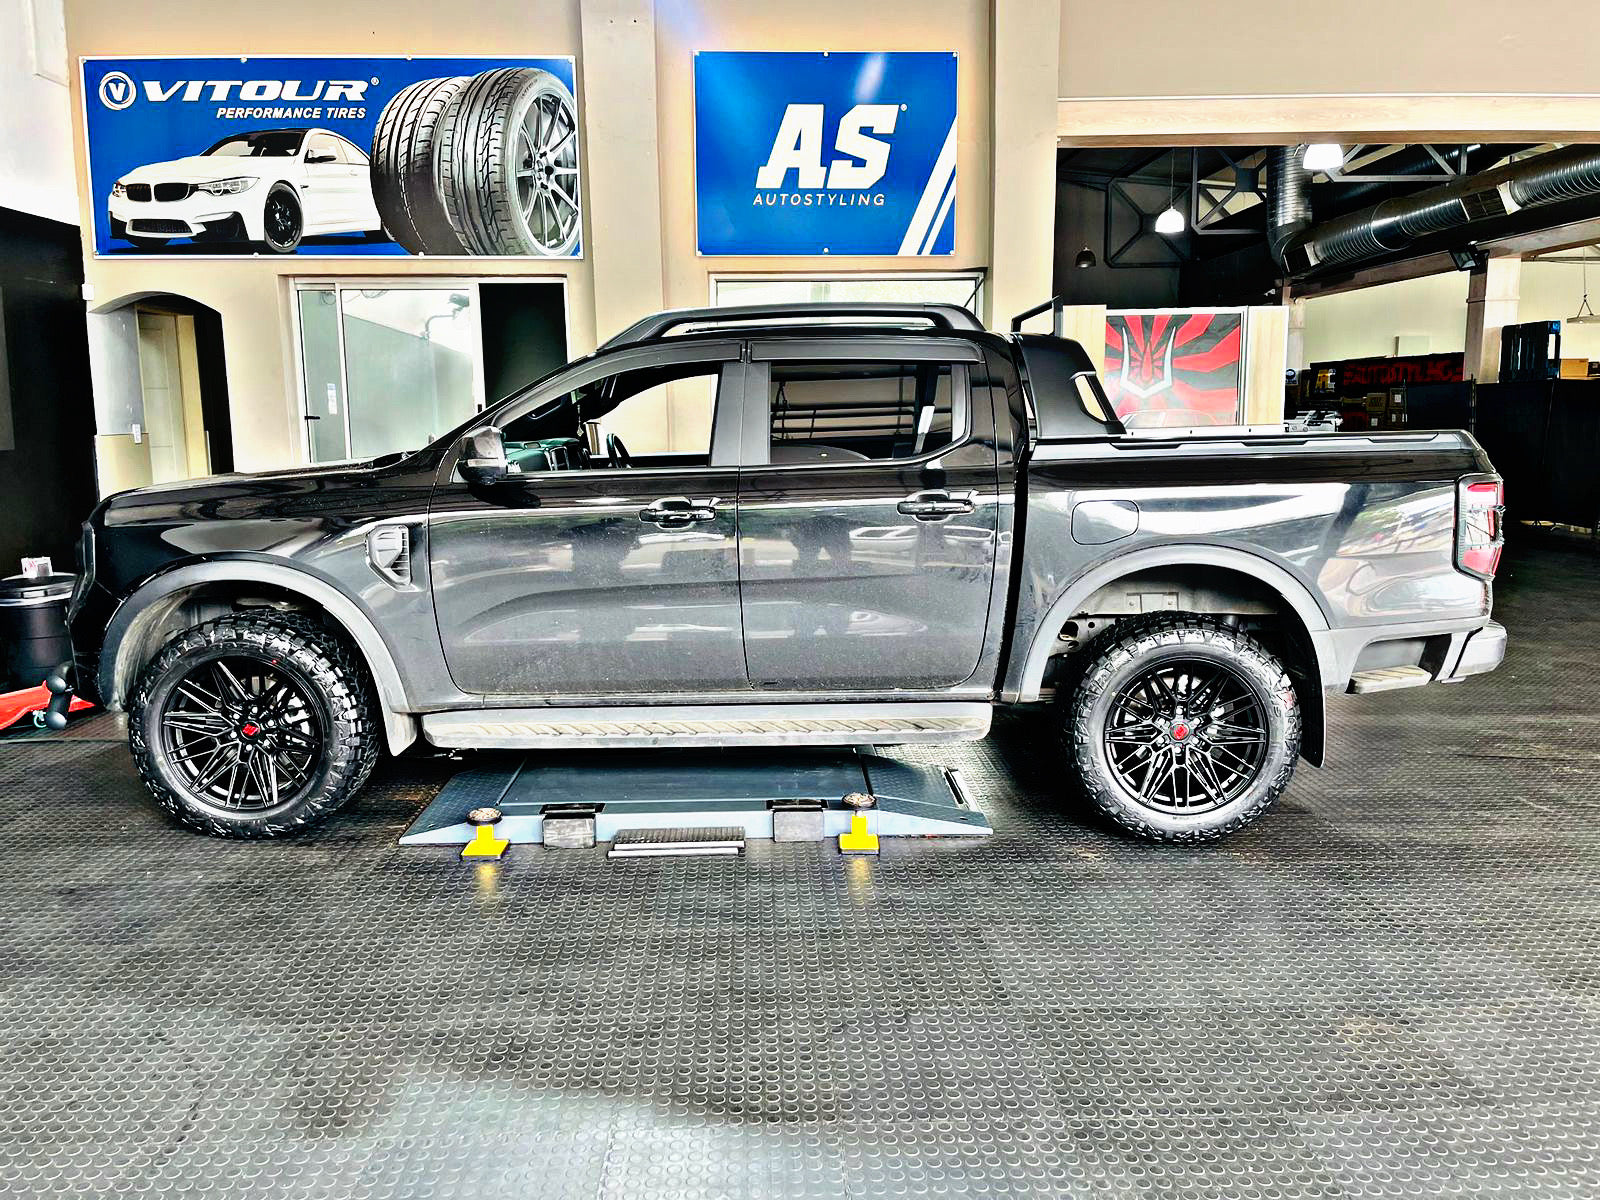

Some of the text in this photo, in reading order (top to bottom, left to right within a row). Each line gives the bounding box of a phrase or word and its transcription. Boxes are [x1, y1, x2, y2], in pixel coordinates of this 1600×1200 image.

[143, 80, 369, 102] VITOUR
[216, 107, 366, 119] PERFORMANCE TIRES
[755, 103, 899, 189] AS
[752, 193, 885, 206] AUTOSTYLING
